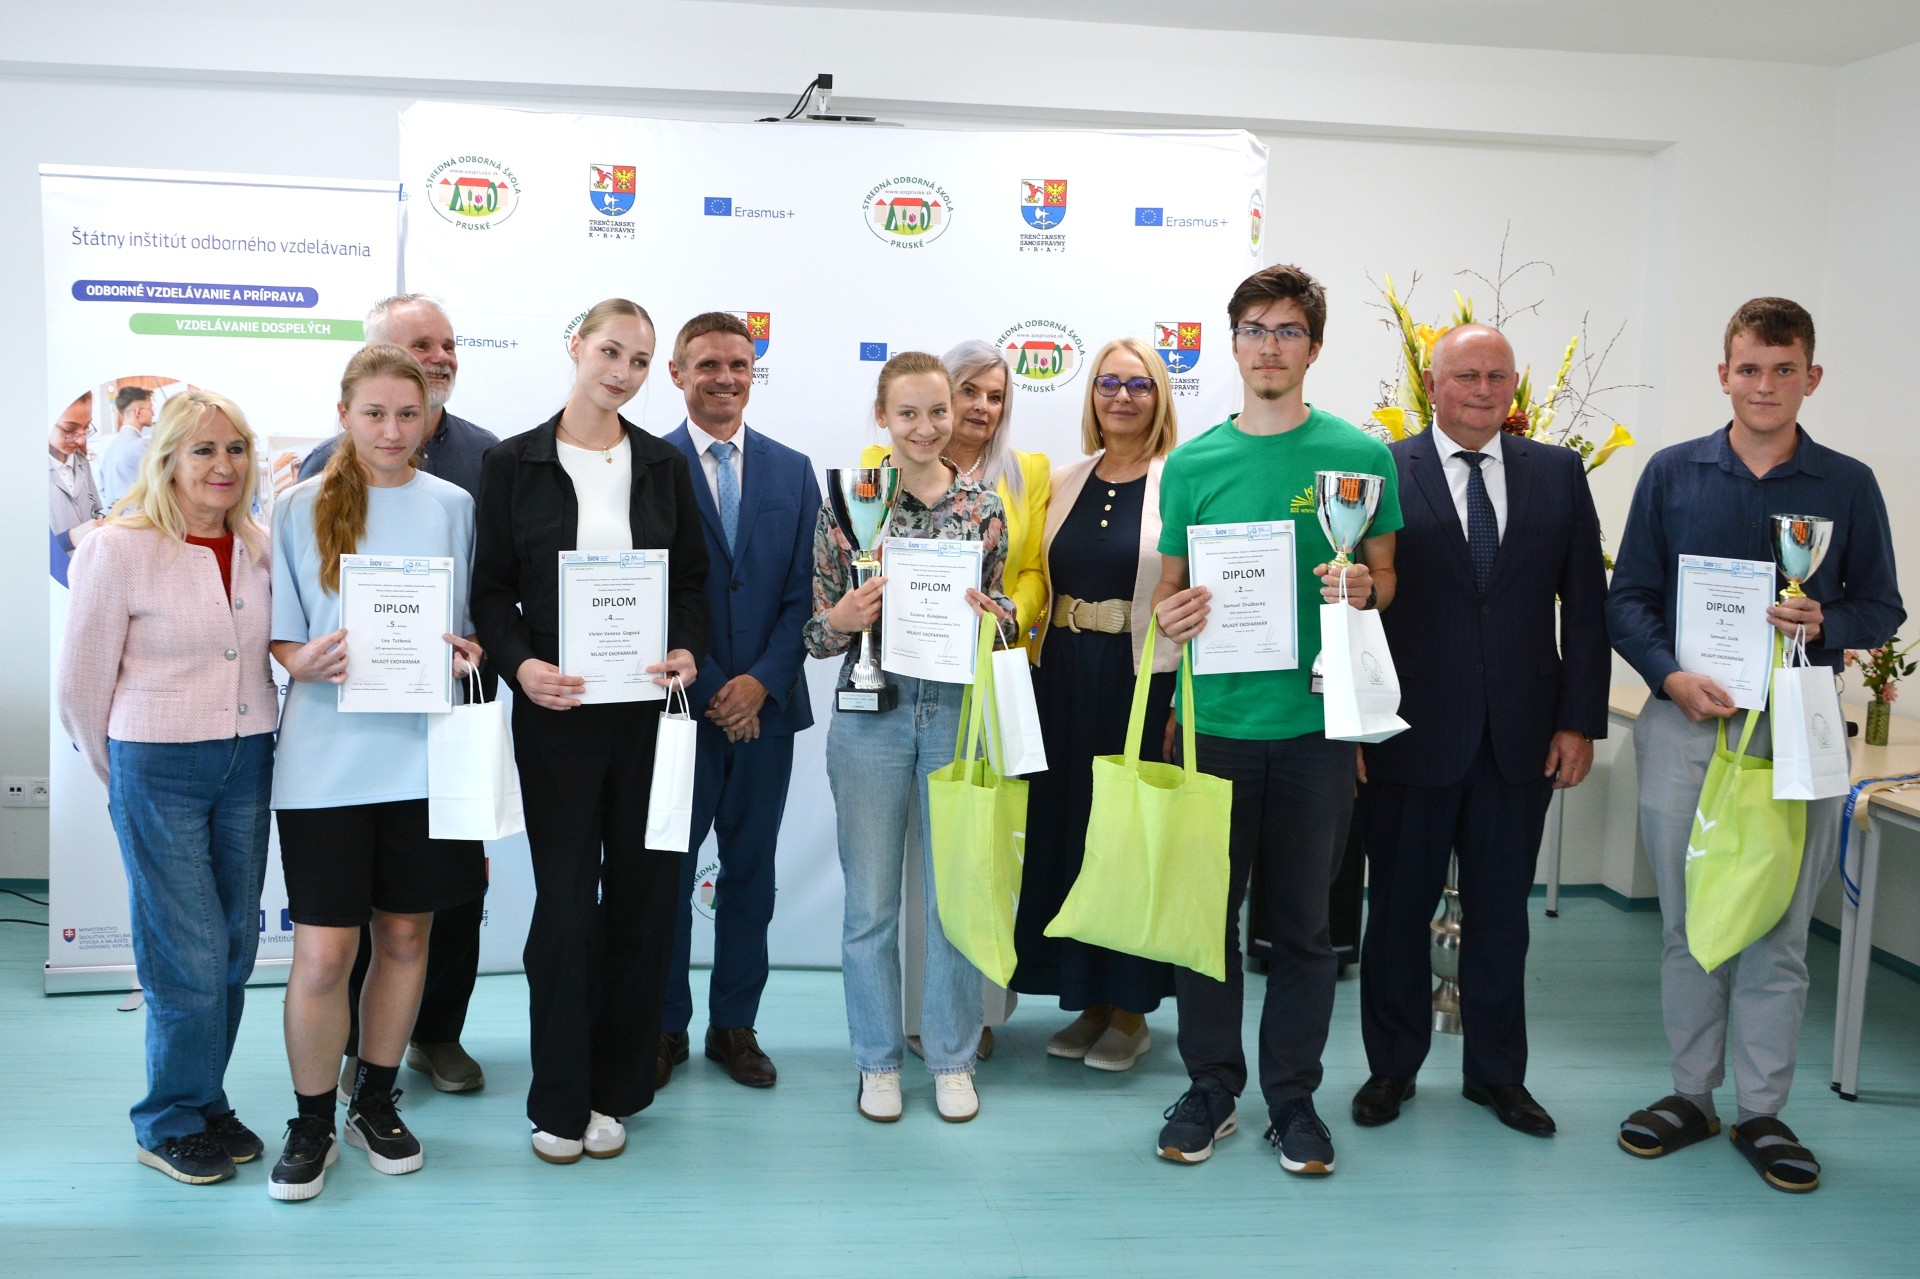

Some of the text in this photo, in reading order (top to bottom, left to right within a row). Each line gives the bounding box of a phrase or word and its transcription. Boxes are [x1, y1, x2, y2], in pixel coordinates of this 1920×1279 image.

[425, 155, 522, 195] STREDNÁ ODBORNÁ ŠKOLA
[862, 176, 954, 213] STREDNÁ ODBORNÁ ŠKOLA
[734, 206, 796, 219] Erasmus+
[455, 220, 491, 231] PRUSKÉ
[589, 219, 636, 227] TRENČIANSKY
[1166, 216, 1228, 228] Erasmus+
[589, 226, 636, 234] SAMOSPRÁVNY
[71, 226, 371, 257] Štátny inštitút odborného vzdelávania
[890, 239, 924, 249] PRUSKÉ
[1020, 239, 1066, 247] SAMOSPRÁVNY
[86, 283, 305, 303] ODBORNÉ VZDELÁVANIE A PRÍPRAVA
[176, 317, 331, 335] VZDELÁVANIE DOSPELÝCH
[563, 308, 590, 340] STREDN
[455, 335, 519, 349] Erasmus+
[995, 319, 1086, 356] TREDNÁ ODBORNÁ ŠKOLA
[1021, 383, 1056, 393] PRUSKÉ
[1222, 568, 1265, 580] DIPLOM
[910, 581, 951, 593] DIPLOM
[592, 597, 636, 607] DIPLOM
[1706, 601, 1745, 614] DIPLOM
[374, 603, 420, 614] DIPLOM
